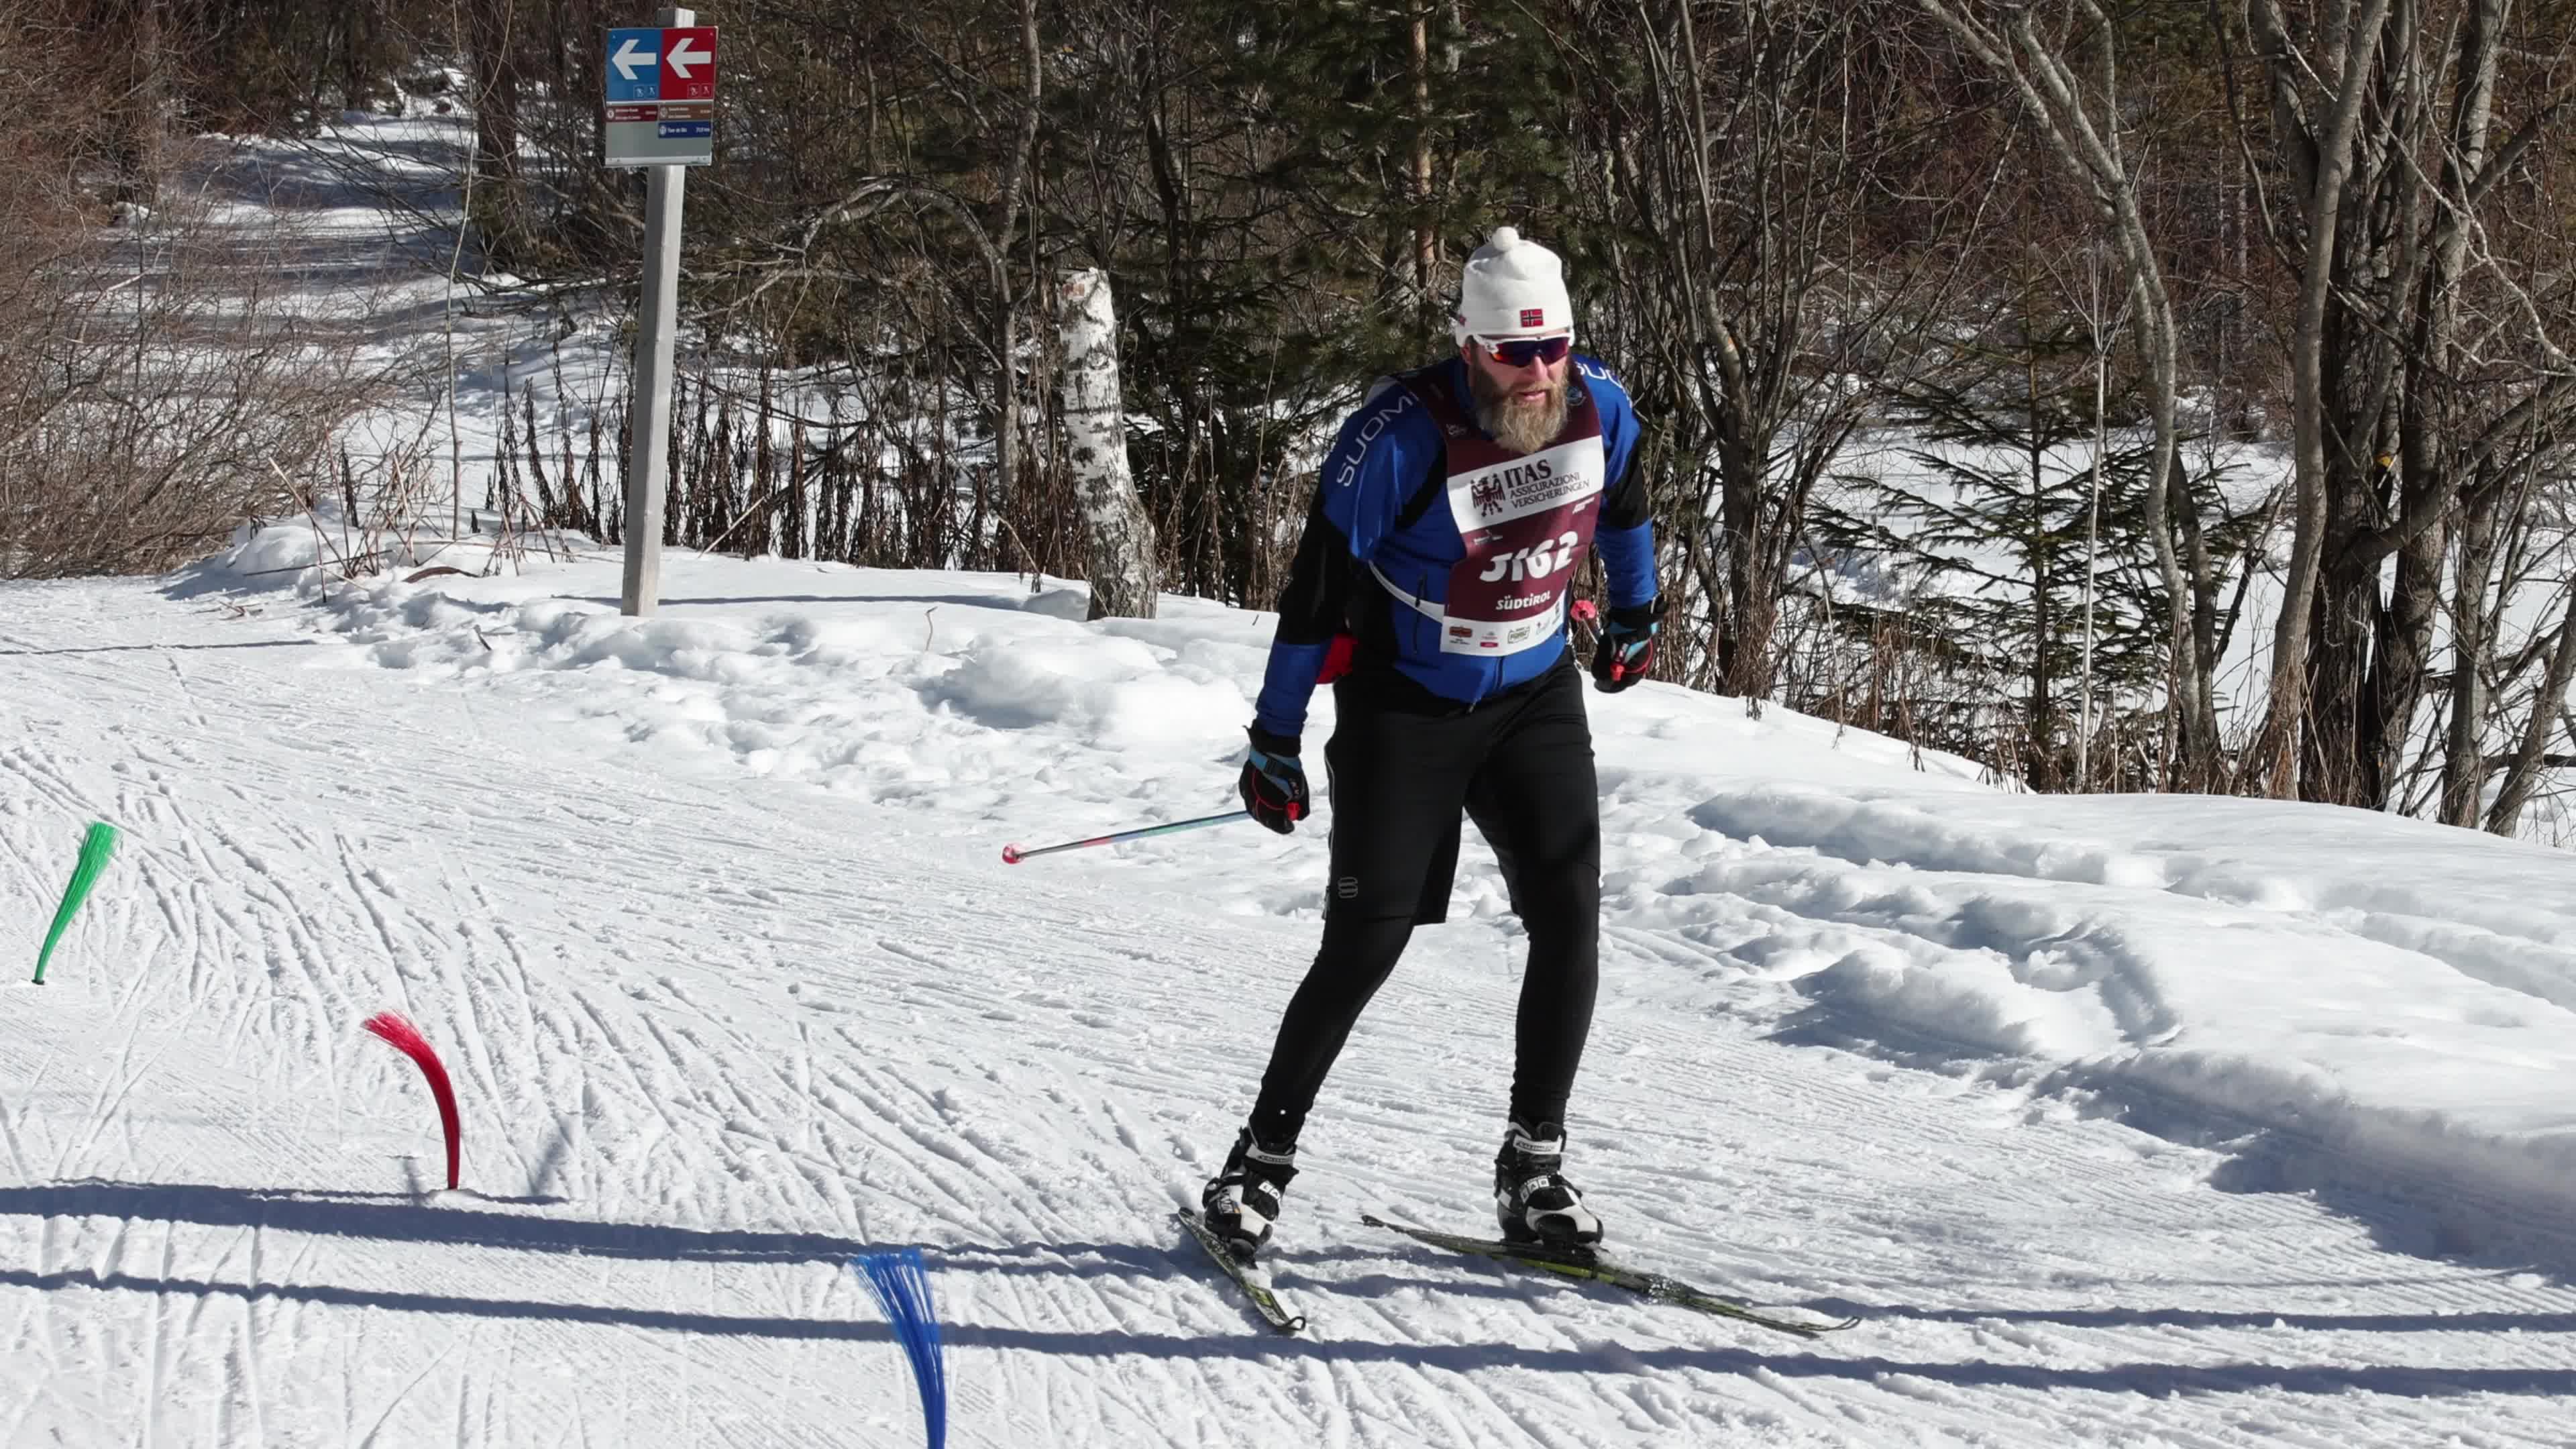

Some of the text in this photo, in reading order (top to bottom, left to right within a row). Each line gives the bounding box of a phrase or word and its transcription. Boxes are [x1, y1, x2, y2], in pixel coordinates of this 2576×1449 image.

[1336, 391, 1419, 487] SUOMI
[1503, 459, 1552, 489] ITAS
[1510, 472, 1580, 499] ASSICURAZIONI
[1511, 478, 1590, 508] VERSICHERUNGEN
